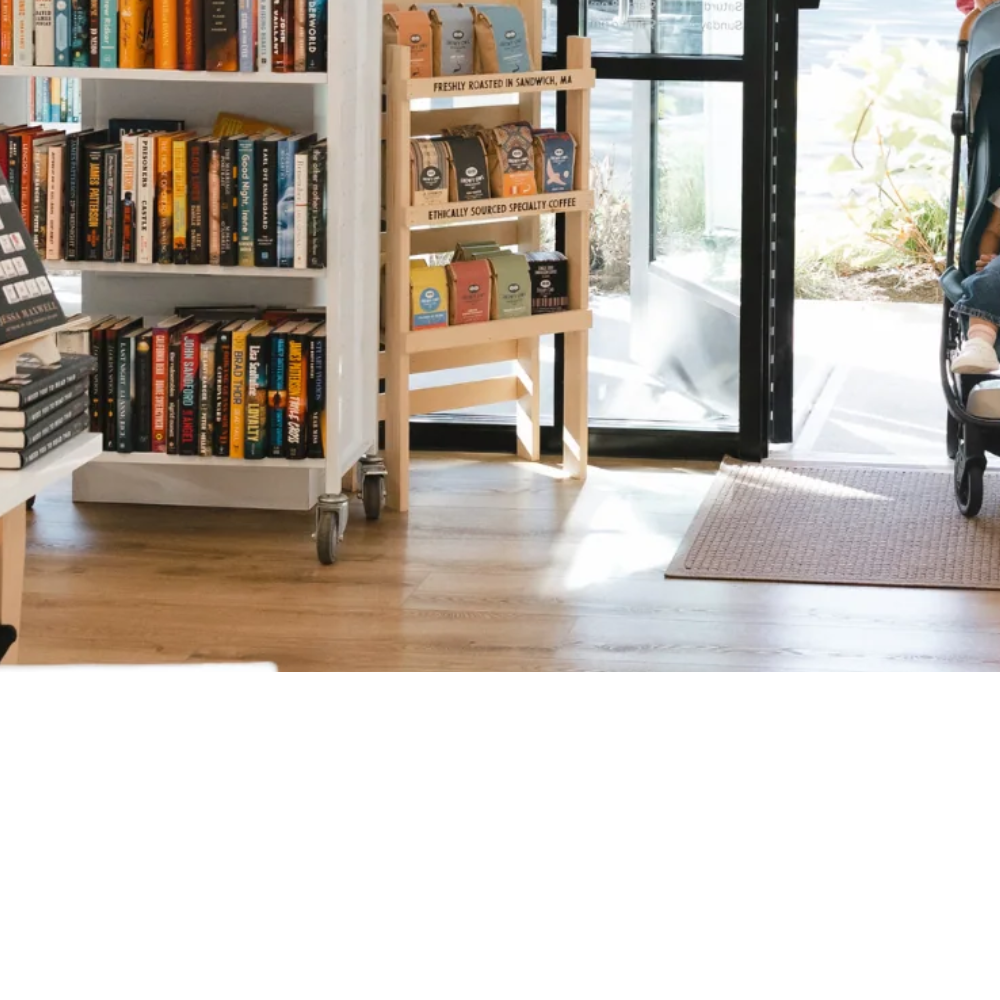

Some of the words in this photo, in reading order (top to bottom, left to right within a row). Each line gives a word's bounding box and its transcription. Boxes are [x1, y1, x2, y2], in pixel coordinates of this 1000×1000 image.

[433, 82, 466, 92] FRESHLY
[468, 79, 503, 90] ROASTED
[505, 78, 513, 88] IN
[516, 76, 558, 87] SANDWICH,
[560, 75, 572, 84] MA
[241, 154, 250, 179] Good
[312, 150, 321, 160] the
[89, 162, 100, 186] JAMES
[312, 162, 320, 182] other
[239, 181, 250, 207] Night,
[312, 184, 320, 213] mothers
[88, 188, 100, 227] PATTERSON
[428, 207, 468, 220] ETHICALLY
[471, 204, 506, 216] SOURCED
[509, 200, 547, 212] SPECIALTY
[549, 197, 576, 208] COFFEE
[241, 210, 250, 233] Irene
[183, 336, 193, 359] JOHN
[249, 345, 261, 361] Lisa
[289, 340, 302, 361] JAMES
[315, 341, 323, 370] STUART
[201, 360, 209, 374] LAST
[233, 350, 243, 377] BRAD
[182, 361, 194, 406] SANDFORD
[248, 362, 261, 396] Scottoline
[288, 362, 302, 397] PATTERSON
[315, 371, 323, 401] WOODS
[233, 380, 243, 405] THOR
[247, 403, 260, 442] LOYALTY
[288, 421, 300, 444] CROSS
